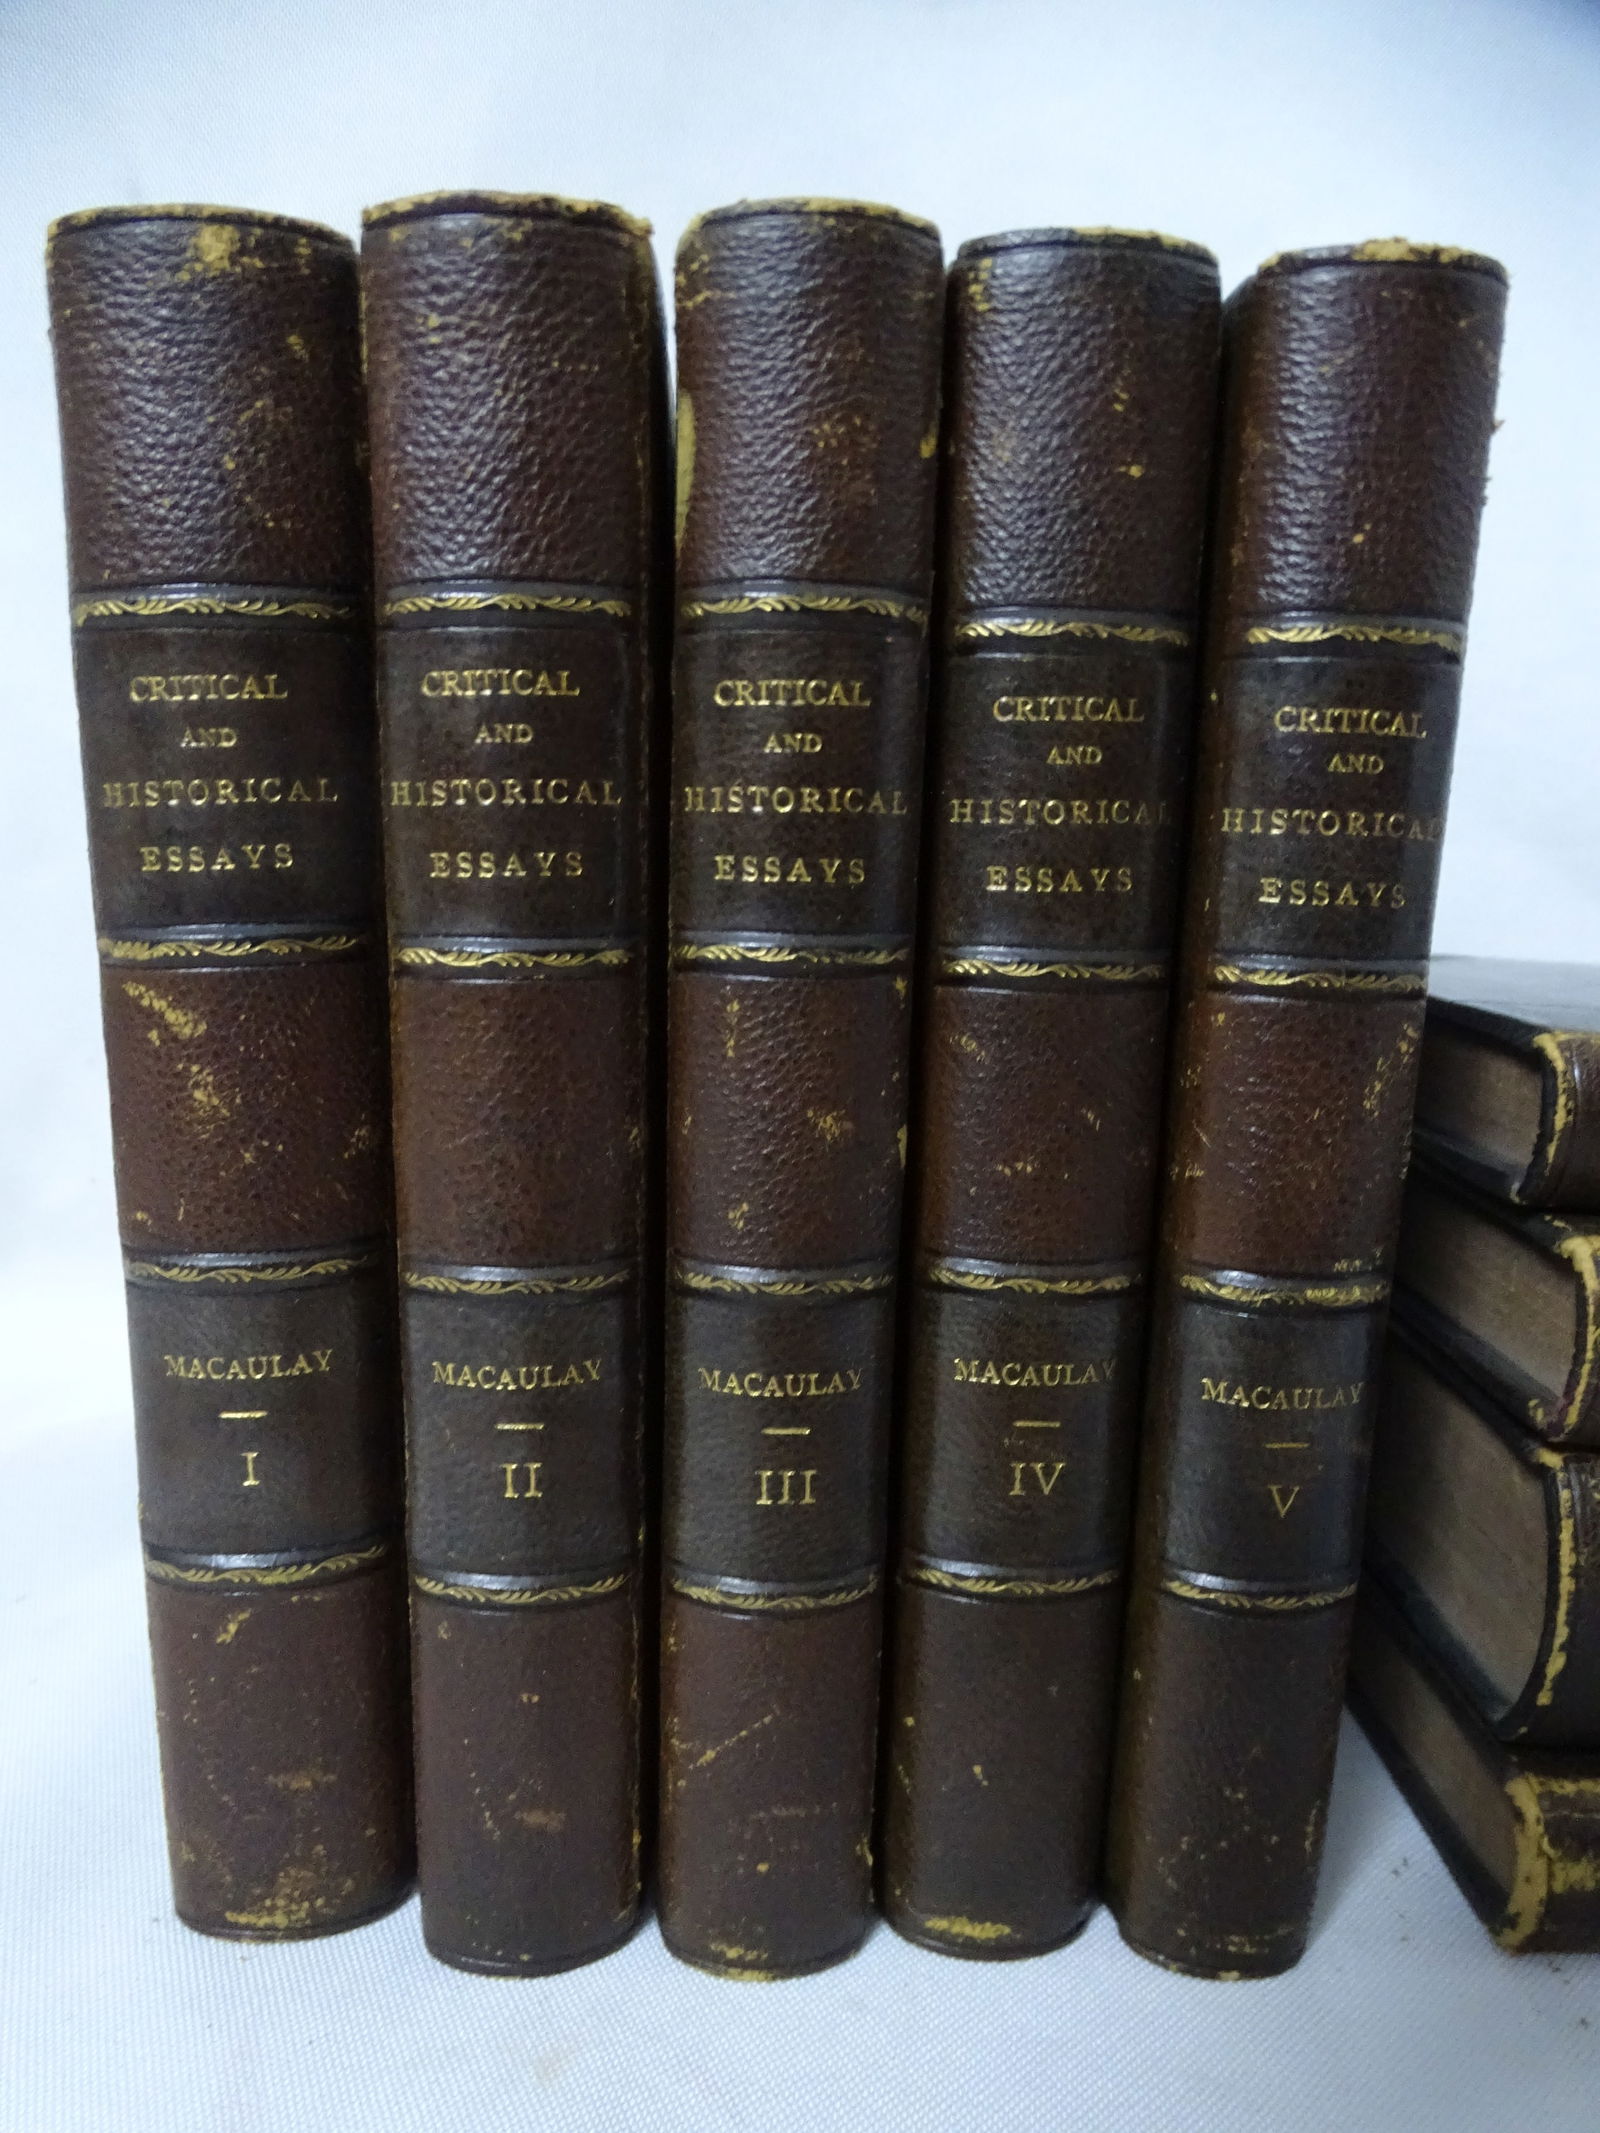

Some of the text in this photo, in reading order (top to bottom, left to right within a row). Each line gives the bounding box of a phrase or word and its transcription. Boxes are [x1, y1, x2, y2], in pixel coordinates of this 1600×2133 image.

[129, 674, 288, 702] CRITICAL
[421, 669, 580, 696] CRITICAL
[713, 679, 872, 707] CRITICAL
[993, 696, 1145, 722] CRITICAL
[1274, 705, 1428, 739] CRITICAL
[180, 727, 238, 748] AND
[474, 723, 534, 744] AND
[763, 733, 823, 754] AND
[1046, 746, 1103, 765] AND
[1327, 753, 1385, 775] AND
[102, 778, 339, 807] HISTORICAL
[390, 778, 622, 807] HISTORICAL
[684, 786, 908, 815] HISTORICAL
[139, 843, 294, 873] ESSAYS
[429, 851, 584, 878] ESSAYS
[713, 855, 866, 884] ESSAYS
[985, 865, 1134, 893] ESSAYS
[1257, 877, 1406, 909] ESSAYS
[164, 1349, 333, 1380] MACAULAY
[432, 1359, 602, 1391] MACAULAY
[953, 1357, 1117, 1387] MACAULAY
[698, 1367, 863, 1398] MACAULAY
[1201, 1377, 1365, 1410] MACAULAY
[241, 1452, 261, 1487] I
[501, 1462, 543, 1499] II
[1008, 1461, 1067, 1496] IV
[754, 1469, 818, 1505] III
[1267, 1484, 1301, 1519] V
